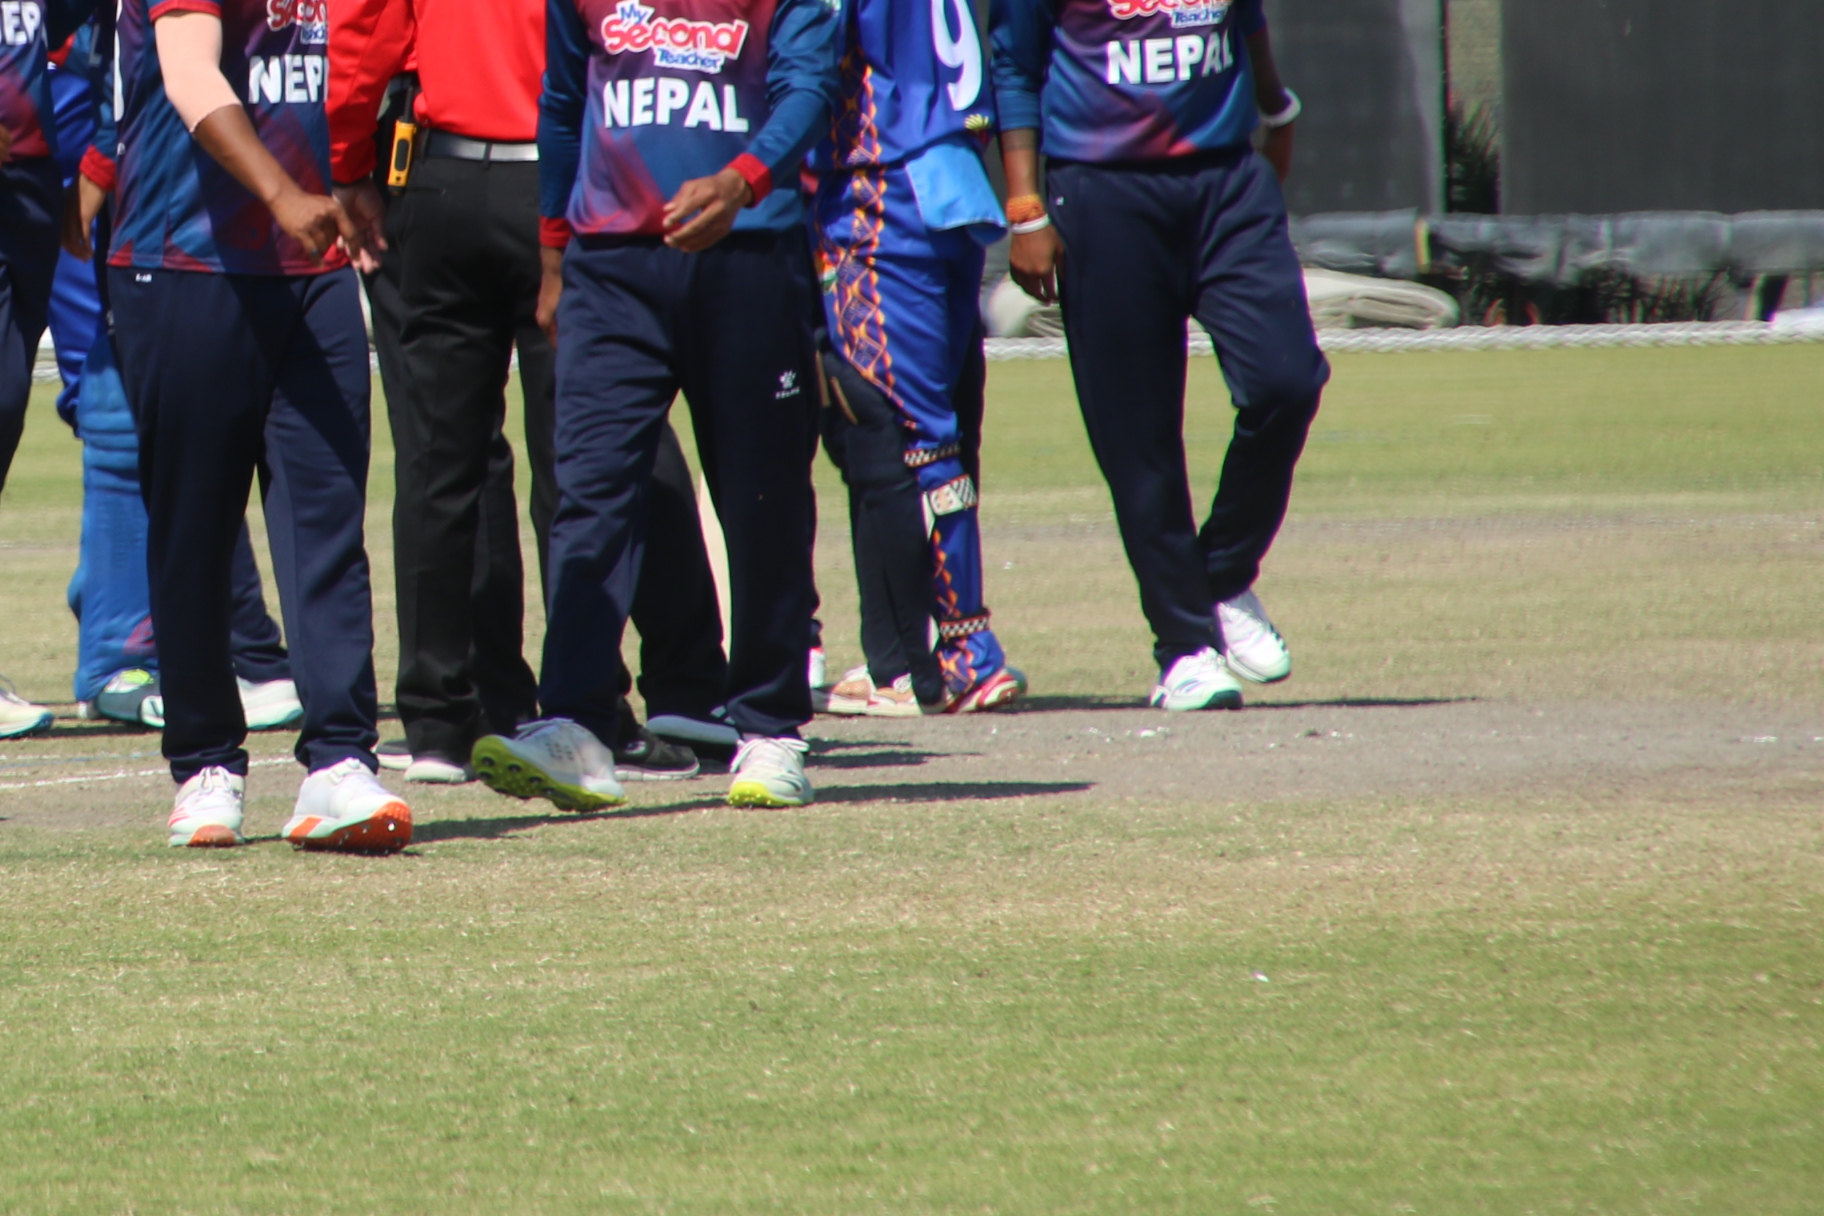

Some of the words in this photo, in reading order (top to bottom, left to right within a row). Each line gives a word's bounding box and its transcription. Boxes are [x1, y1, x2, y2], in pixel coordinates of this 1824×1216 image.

[620, 3, 648, 25] My
[603, 20, 747, 55] Second
[657, 47, 721, 68] Teacher
[1107, 28, 1233, 84] NEPAL
[248, 54, 328, 105] NEP
[602, 77, 750, 133] NEPAL
